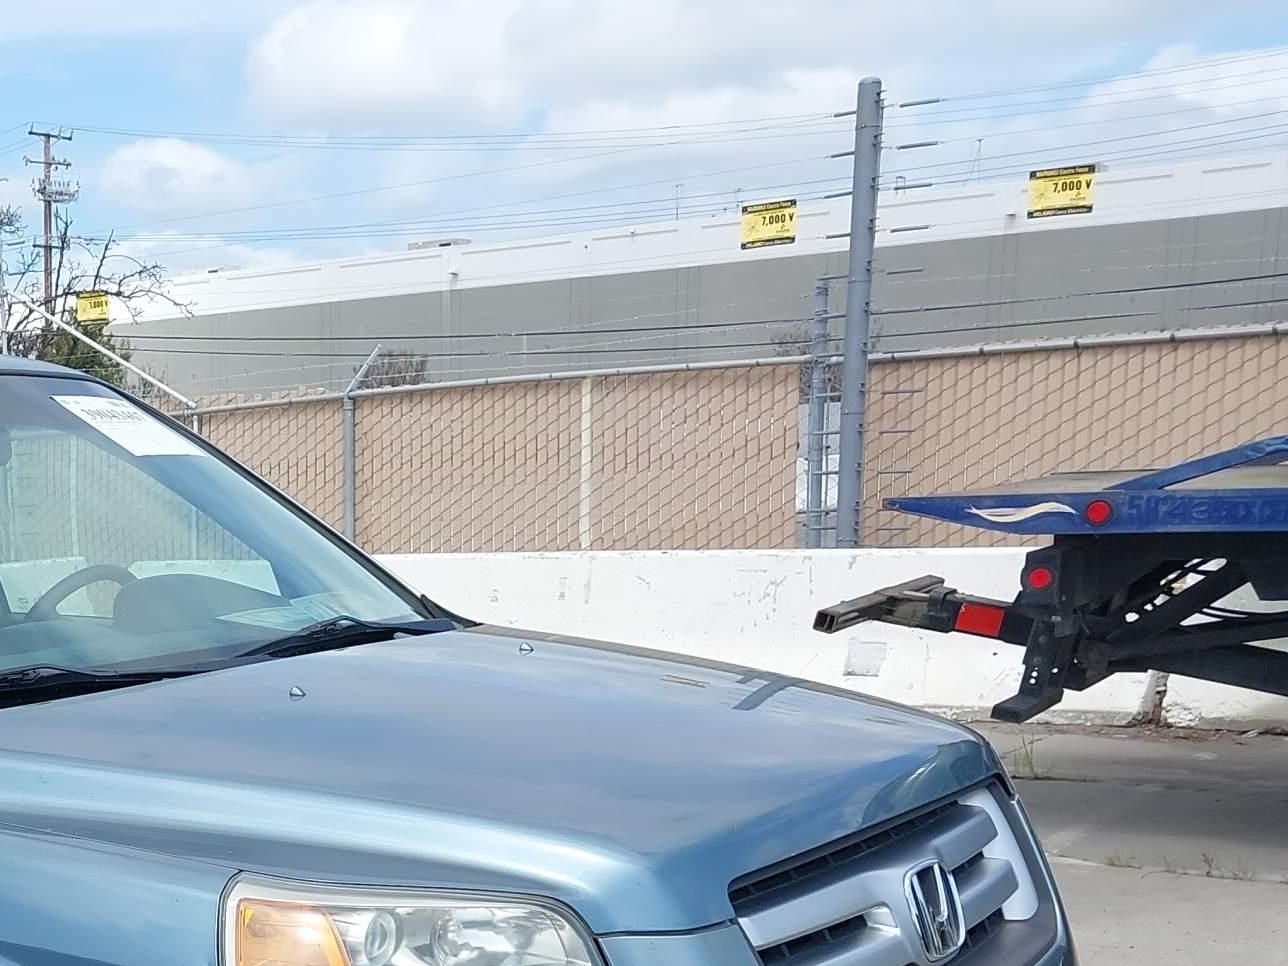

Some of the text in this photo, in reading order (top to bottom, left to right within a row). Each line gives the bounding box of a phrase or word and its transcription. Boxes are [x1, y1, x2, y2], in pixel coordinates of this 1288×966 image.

[1052, 179, 1092, 194] 7,000 V
[761, 212, 794, 227] 7,000 V
